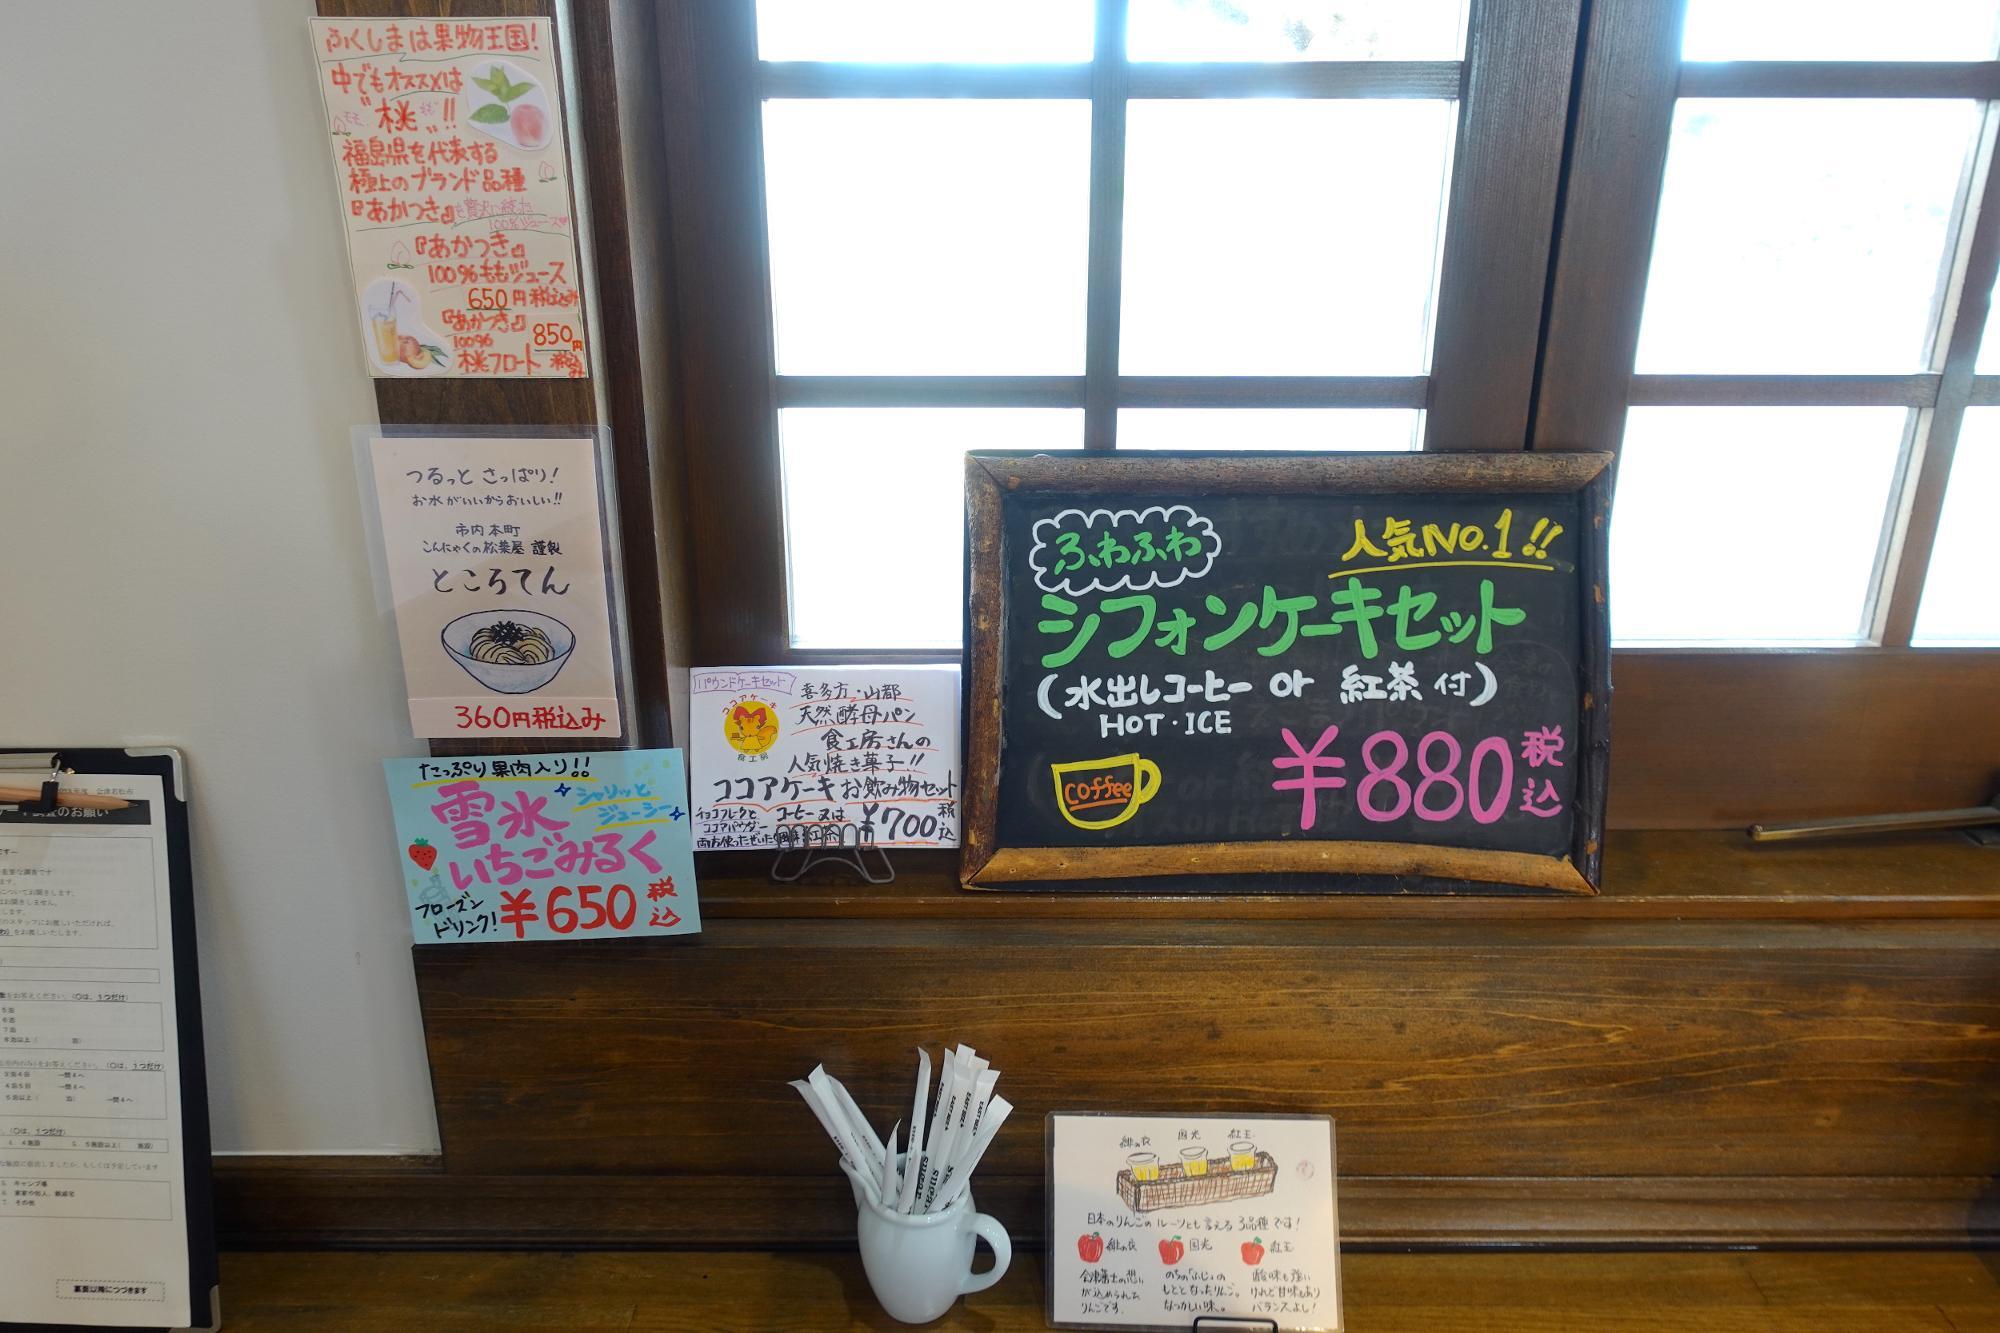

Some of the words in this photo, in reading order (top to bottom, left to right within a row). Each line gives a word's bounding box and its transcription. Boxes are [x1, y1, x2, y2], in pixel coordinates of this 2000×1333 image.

[326, 23, 539, 53] ふくしまは果物王国!
[331, 62, 464, 94] 中でもオススメは
[341, 136, 498, 167] 福島県を代表する
[349, 167, 527, 194] 極上のブランド品種
[428, 259, 567, 284] 100%ももジュース
[457, 343, 541, 376] 桃フロート
[531, 540, 563, 556] 謹製
[1054, 526, 1202, 575] ふわふわ
[432, 567, 570, 596] ところてん
[1037, 577, 1527, 669] シフォンケーキセット
[698, 675, 785, 690] パウンドケーキセット
[1340, 661, 1422, 704] 紅茶
[454, 705, 606, 731] 360円税込み
[795, 704, 917, 726] 天然酵母パン
[821, 728, 931, 750] 食工房さんの
[1272, 725, 1514, 831] ¥880
[575, 783, 652, 806] シャリッと
[430, 780, 571, 849] 雪氷
[597, 802, 673, 825] ジューシー
[696, 806, 758, 821] チョコフレークと
[704, 821, 768, 833] ココアパウダー
[449, 829, 663, 891] いちごみるく
[415, 891, 485, 919] フローズン
[500, 884, 637, 939] ¥650
[433, 912, 498, 939] ドリンク!
